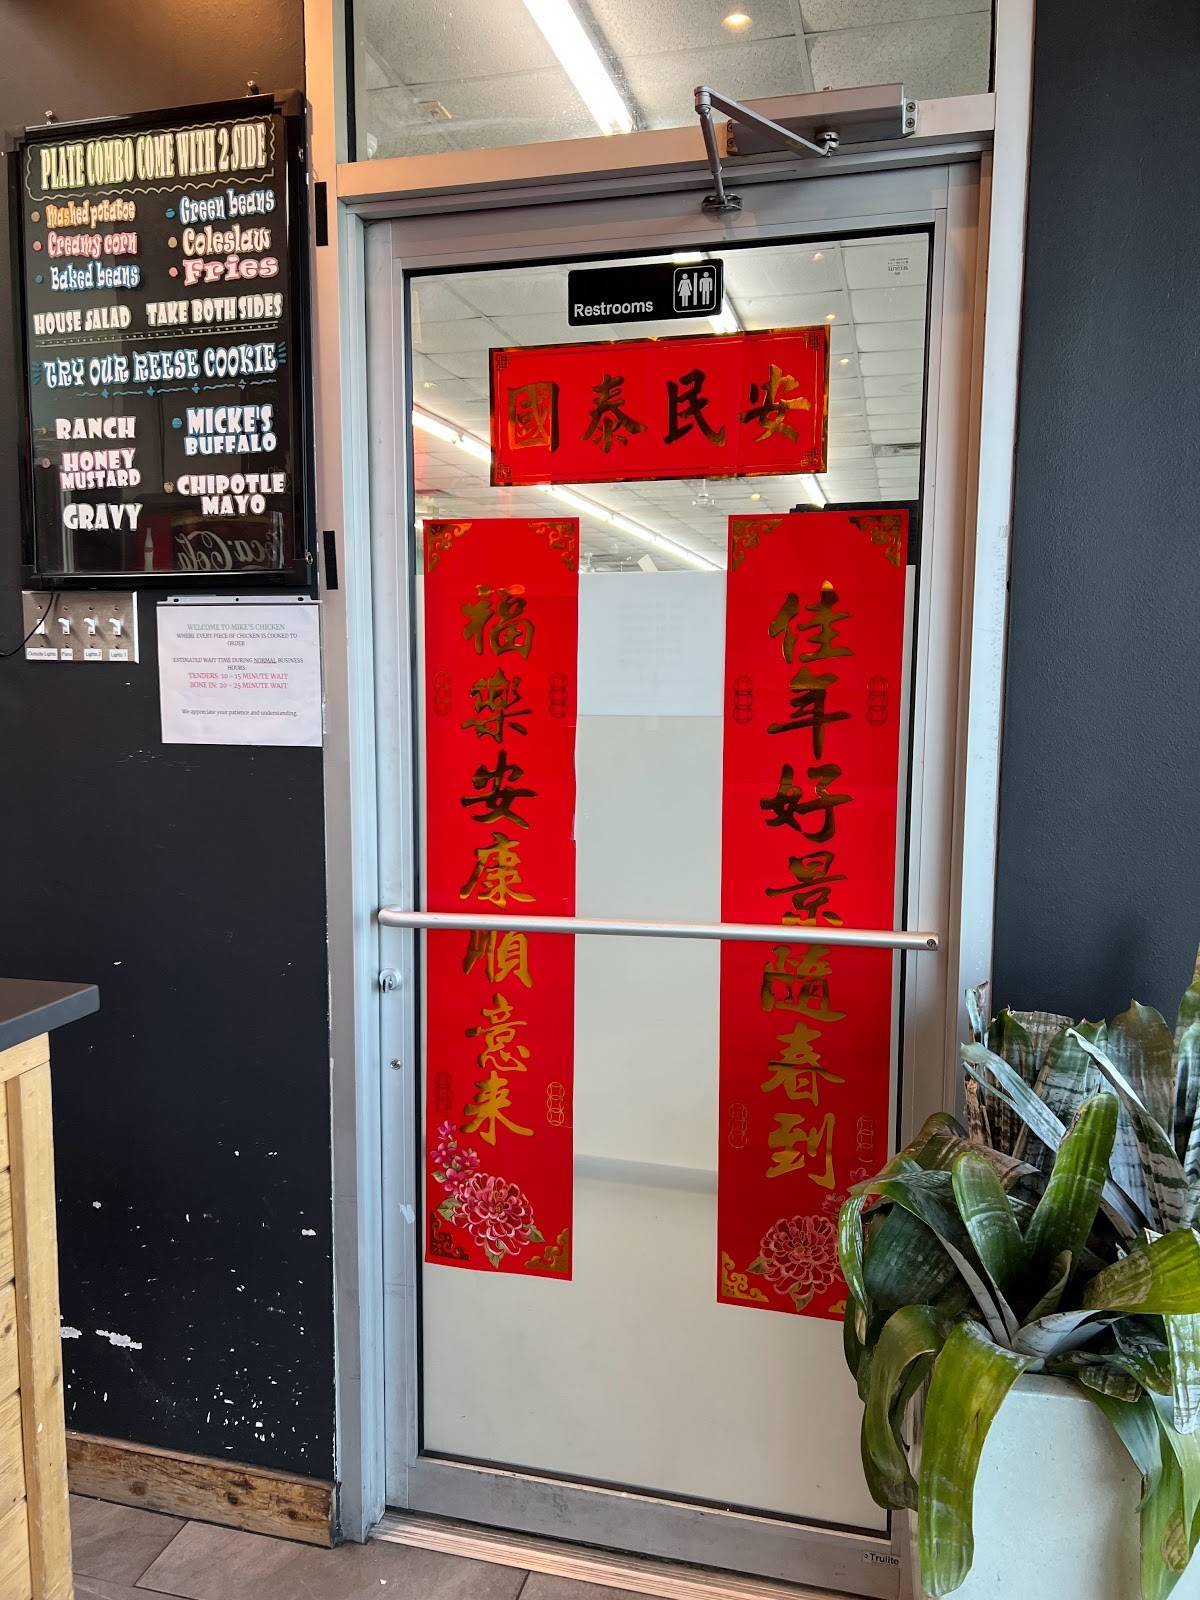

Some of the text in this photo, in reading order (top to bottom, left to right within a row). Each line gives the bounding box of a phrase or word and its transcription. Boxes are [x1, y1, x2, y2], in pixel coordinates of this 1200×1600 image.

[40, 125, 266, 190] PLATE COMBO COME WITH 2 SIDE
[46, 198, 136, 229] Mashed potatoe
[180, 187, 275, 225] Green beans
[48, 231, 137, 259] Creamy corn
[183, 223, 271, 256] Coleslaw
[50, 261, 140, 290] Baked beans
[183, 254, 279, 286] Fries
[33, 305, 131, 335] HOUSE SALAD
[146, 293, 283, 326] TAKE BOTH SIDES
[574, 301, 653, 318] Restrooms
[44, 342, 278, 389] TRY OUR REESE COOKIE
[186, 404, 273, 434] MICKE'S
[507, 363, 810, 453] 國泰民安
[56, 416, 136, 440] RANCH
[184, 432, 277, 456] BUFFALO
[62, 448, 136, 472] HONEY
[60, 469, 140, 491] MUSTARD
[177, 472, 286, 496] CHIPOTLE
[63, 503, 143, 531] GRAVY
[201, 494, 266, 516] MAYO
[256, 623, 286, 631] CHICKEN
[234, 682, 241, 690] 25
